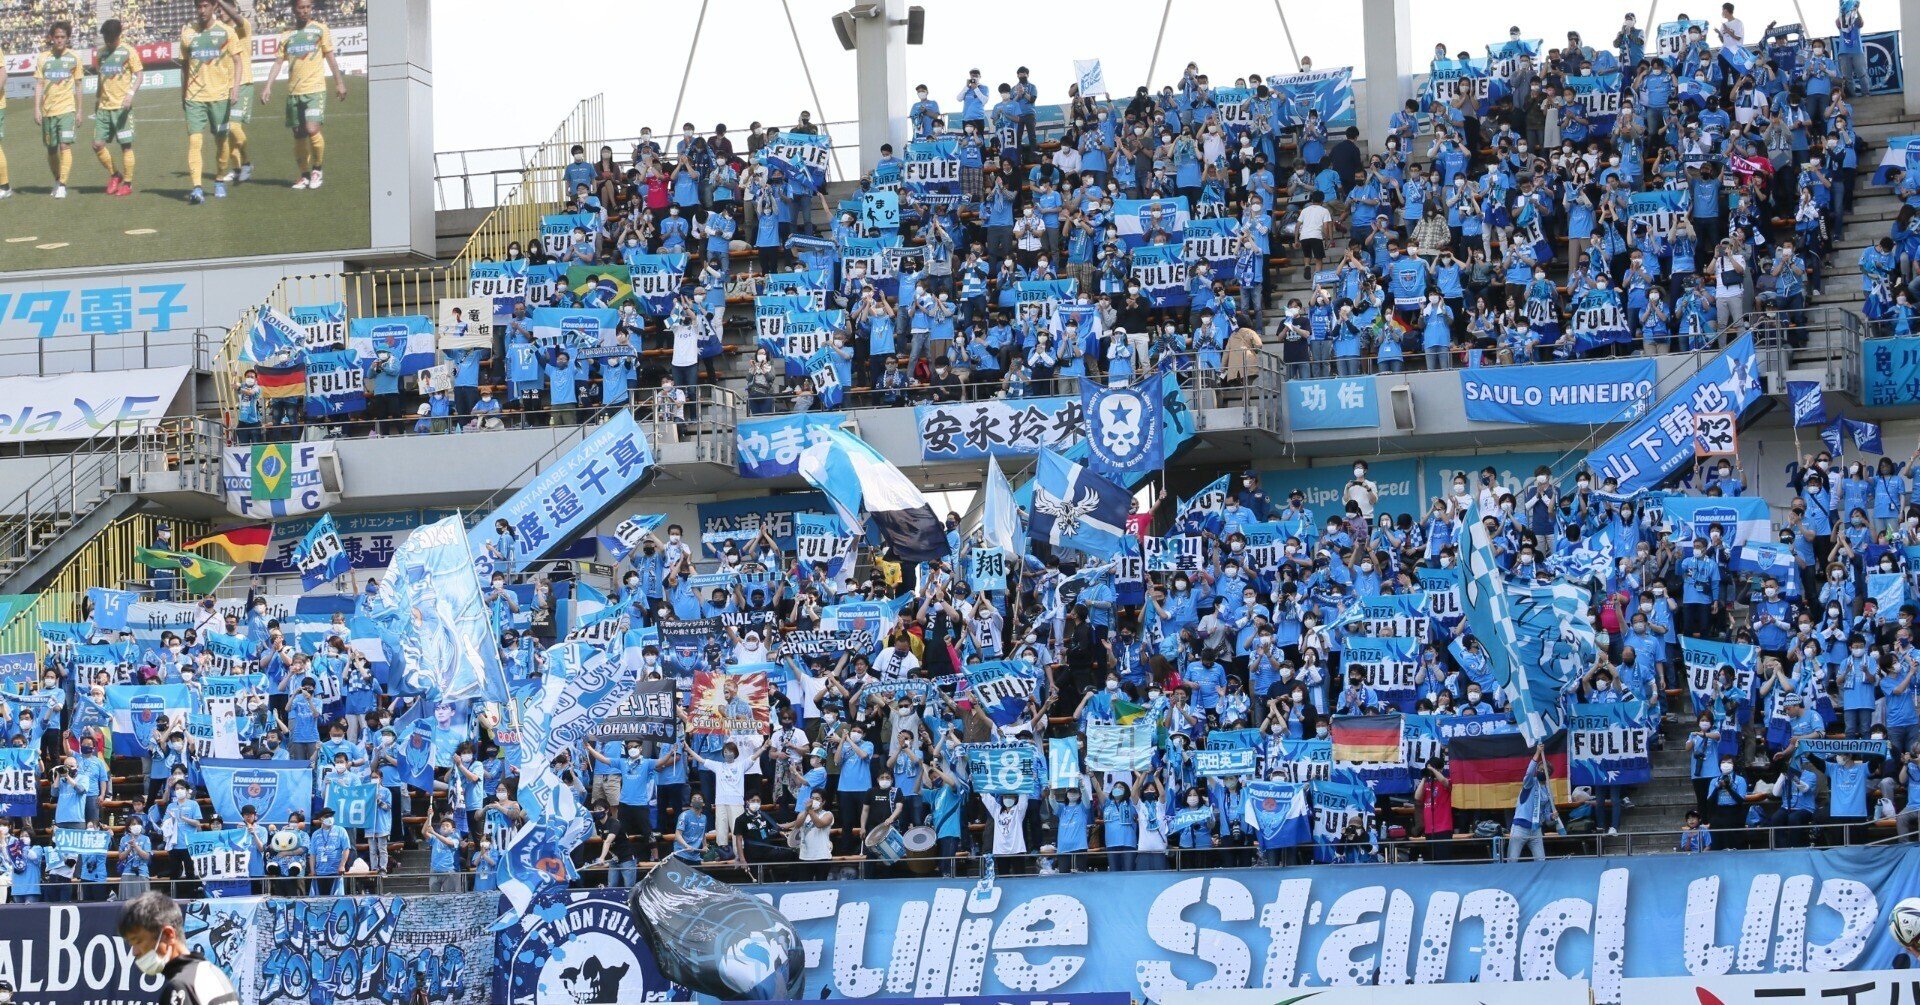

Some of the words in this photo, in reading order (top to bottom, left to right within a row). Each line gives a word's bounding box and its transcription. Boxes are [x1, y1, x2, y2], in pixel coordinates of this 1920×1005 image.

[1436, 77, 1489, 99] FUIE
[906, 162, 959, 181] FULIE
[1186, 237, 1240, 258] FULIE
[472, 277, 525, 298] FULIE
[467, 309, 490, 338] 竜也
[305, 324, 343, 350] ULIE
[310, 372, 364, 399] FULIE
[1465, 380, 1543, 407] SAULO
[1550, 379, 1653, 406] MINEIRO
[922, 398, 1086, 456] 安永玲央
[568, 432, 617, 472] KAZUMA
[1695, 514, 1737, 524] YOKOHAMA
[976, 552, 1003, 578] 翔
[103, 592, 120, 612] 14
[837, 610, 880, 619] YOKOHAMA
[1362, 663, 1415, 687] ULIE
[203, 684, 236, 697] FORZA
[863, 684, 928, 698] YOKOHAMA
[588, 723, 647, 737] OKOHAMA
[693, 717, 721, 730] Saulo
[724, 718, 764, 731] Mineiro
[1570, 716, 1606, 730] FORZA
[1573, 730, 1646, 757] FULIE
[1806, 740, 1883, 754] YOKOHAMA
[1050, 747, 1078, 790] 14
[2, 771, 35, 792] LIE
[234, 775, 278, 785] YOKOHAMA
[334, 786, 369, 799] KOKI
[1249, 787, 1294, 800] YOKOHAMA
[337, 799, 373, 831] 18
[57, 833, 108, 850] 小川航基
[197, 852, 248, 880] ULIE
[540, 907, 594, 945] C'MON
[1135, 866, 1630, 1005] Stand
